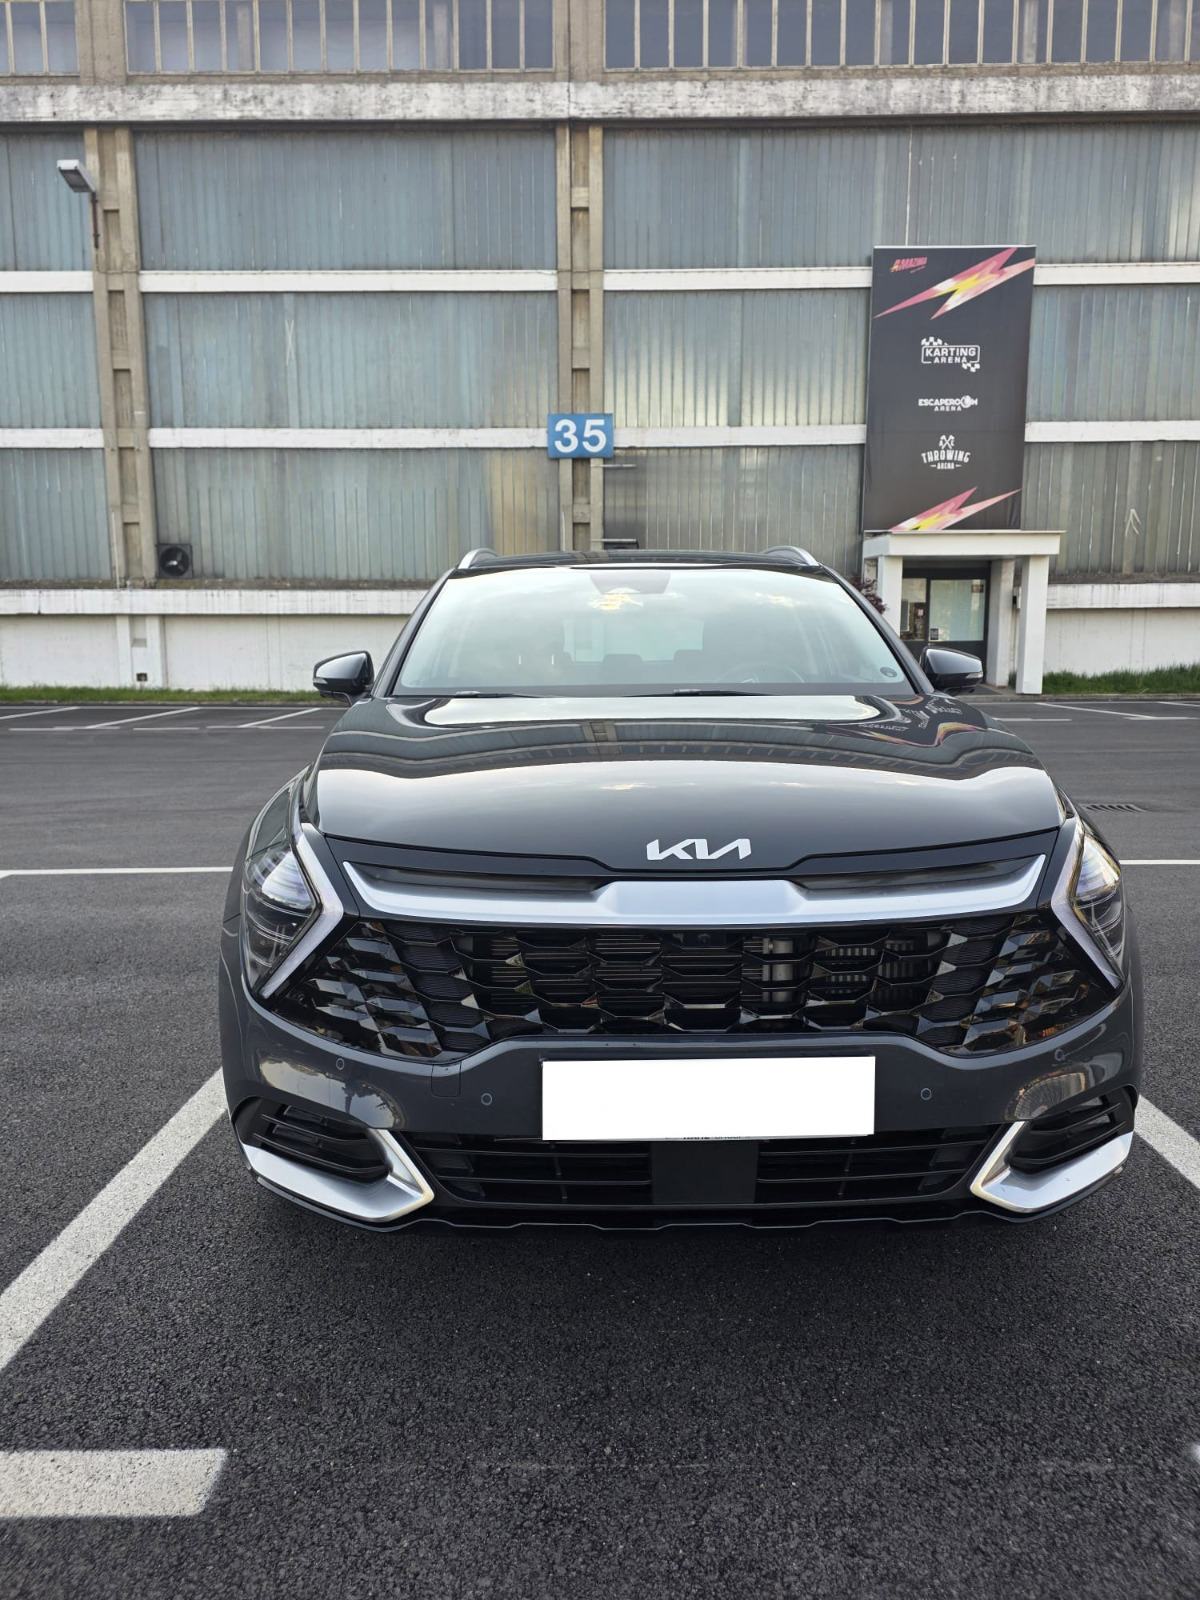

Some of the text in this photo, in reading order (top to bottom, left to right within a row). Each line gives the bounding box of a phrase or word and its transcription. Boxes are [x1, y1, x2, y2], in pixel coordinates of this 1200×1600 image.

[925, 347, 976, 357] KARTING
[933, 356, 967, 364] ARENA
[554, 418, 607, 453] 35
[921, 449, 972, 464] THROWING
[646, 838, 752, 861] KIA
